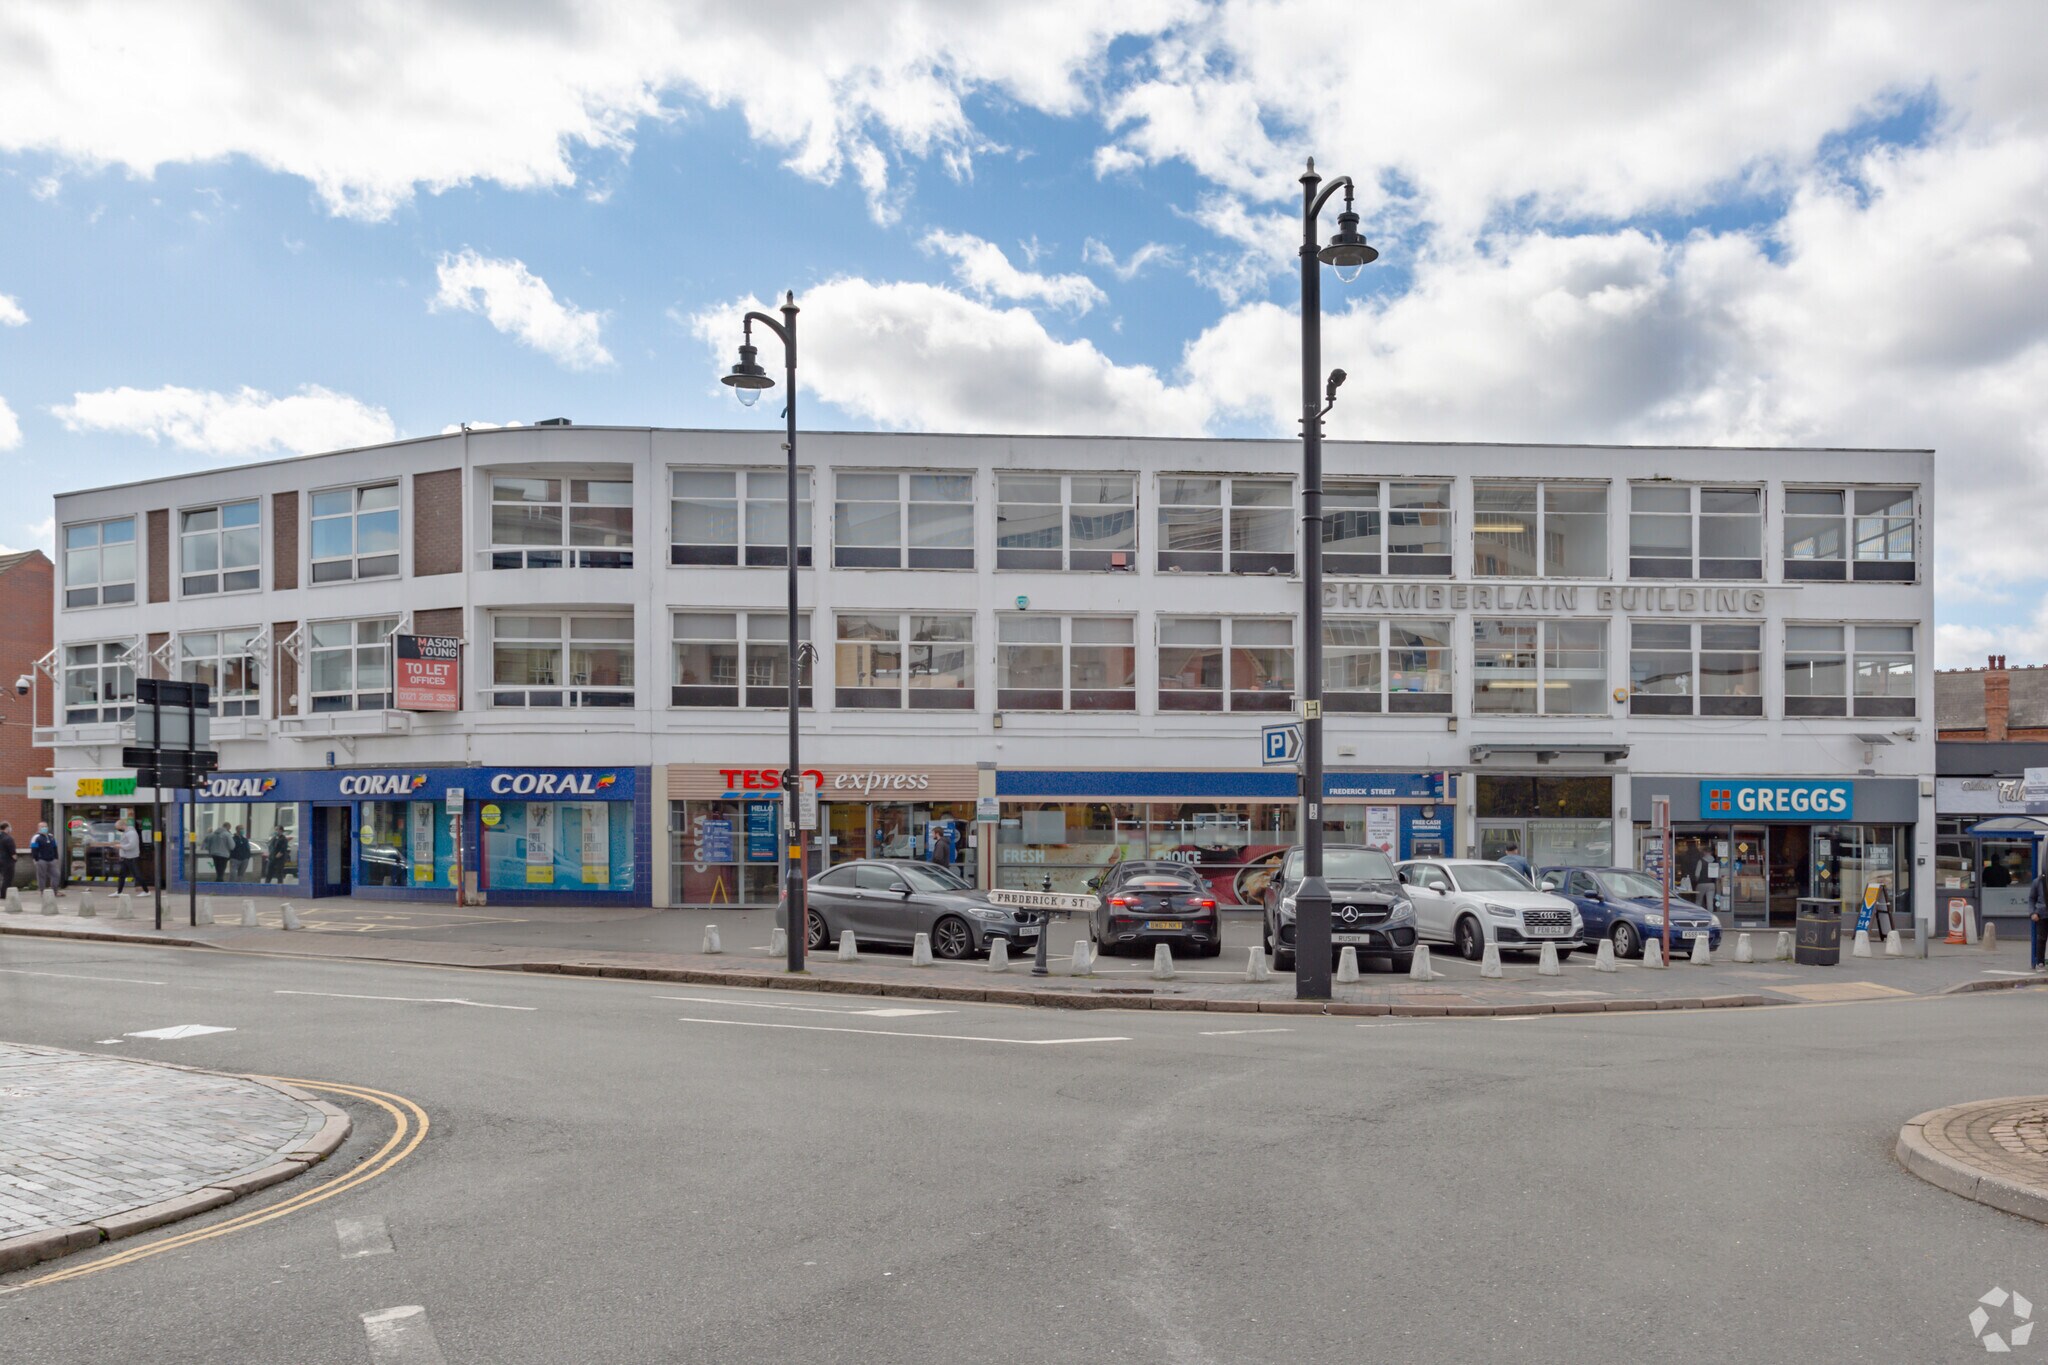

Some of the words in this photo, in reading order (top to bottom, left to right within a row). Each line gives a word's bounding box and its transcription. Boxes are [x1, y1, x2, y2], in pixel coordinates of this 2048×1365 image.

[1322, 583, 1577, 610] CHAMBERLAIN
[1597, 586, 1765, 612] BUILDING
[417, 637, 457, 648] MASON
[418, 647, 457, 657] YOUNG
[405, 662, 423, 674] TO
[426, 663, 450, 676] LET
[410, 676, 446, 685] OFFICES
[1271, 734, 1283, 756] P
[75, 776, 137, 797] SUBWAY
[199, 777, 264, 797] CORAL
[339, 774, 413, 795] CORAL
[490, 773, 596, 794] CORAL
[719, 769, 824, 789] TESO
[834, 772, 929, 796] express
[1737, 787, 1847, 812] GREGGS
[1003, 849, 1045, 863] FRESH
[997, 893, 1058, 906] FREDERICK
[1071, 898, 1085, 907] ST
